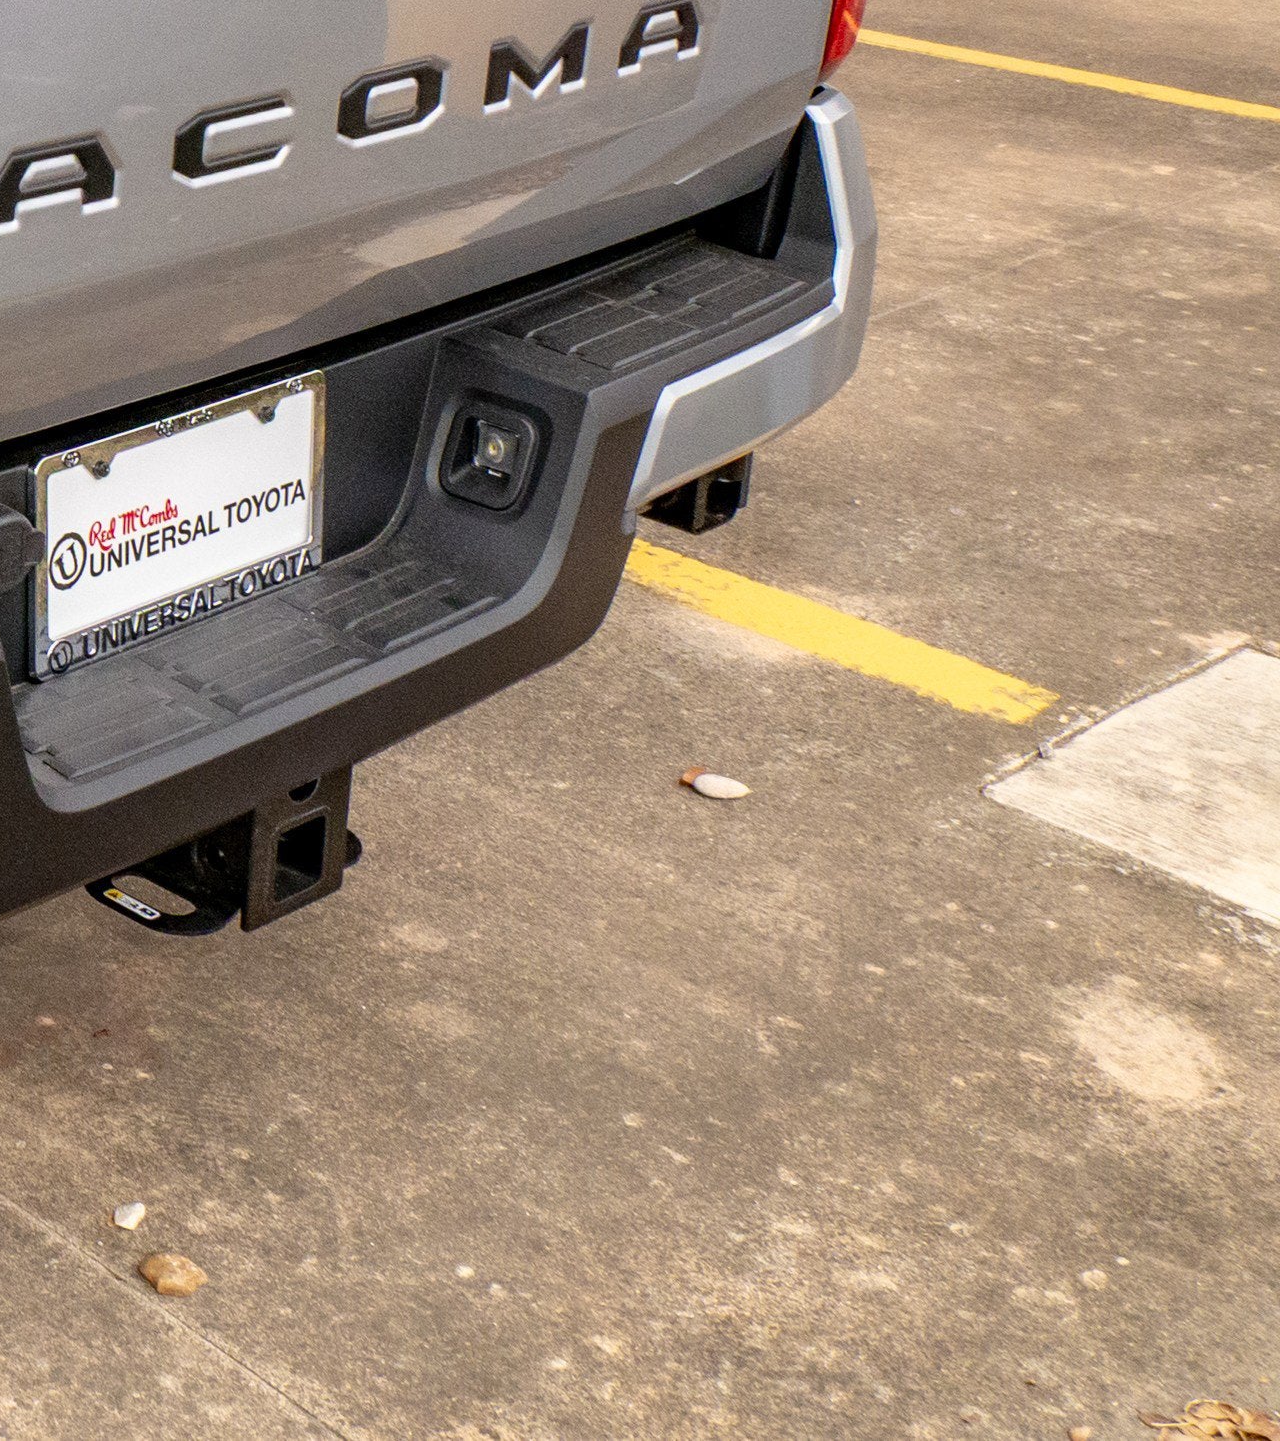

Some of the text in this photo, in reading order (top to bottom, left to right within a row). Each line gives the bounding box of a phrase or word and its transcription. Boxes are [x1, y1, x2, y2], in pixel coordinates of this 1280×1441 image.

[89, 498, 179, 551] Red McCombs
[89, 479, 306, 577] UNIVERSAL TOYOTA
[81, 583, 223, 658] UNIVERSAL
[223, 548, 316, 597] TOYOTA
